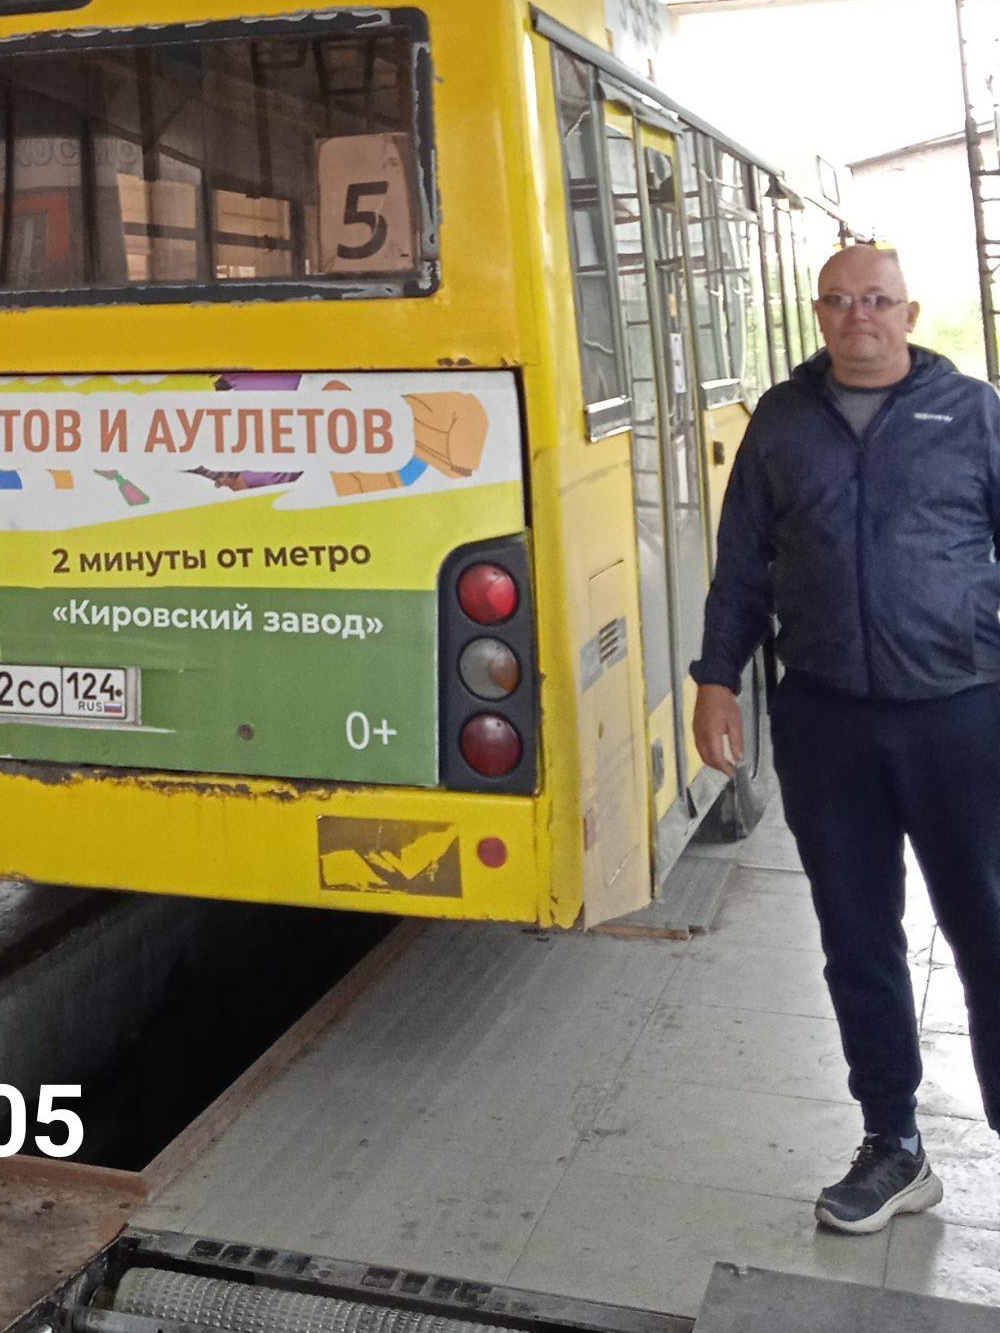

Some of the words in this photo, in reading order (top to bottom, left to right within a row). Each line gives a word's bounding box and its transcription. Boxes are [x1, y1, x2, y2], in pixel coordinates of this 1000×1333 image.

[336, 180, 390, 259] 5
[100, 409, 128, 453] И
[143, 408, 394, 455] АУТЛЕТОВ
[52, 547, 71, 574] 2
[79, 544, 206, 580] минуты
[217, 545, 253, 569] от
[264, 543, 372, 573] метро
[52, 598, 254, 635] «Кировский
[263, 604, 384, 640] завод»
[66, 672, 115, 701] 124
[78, 701, 102, 713] RUS
[345, 711, 398, 750] 0+
